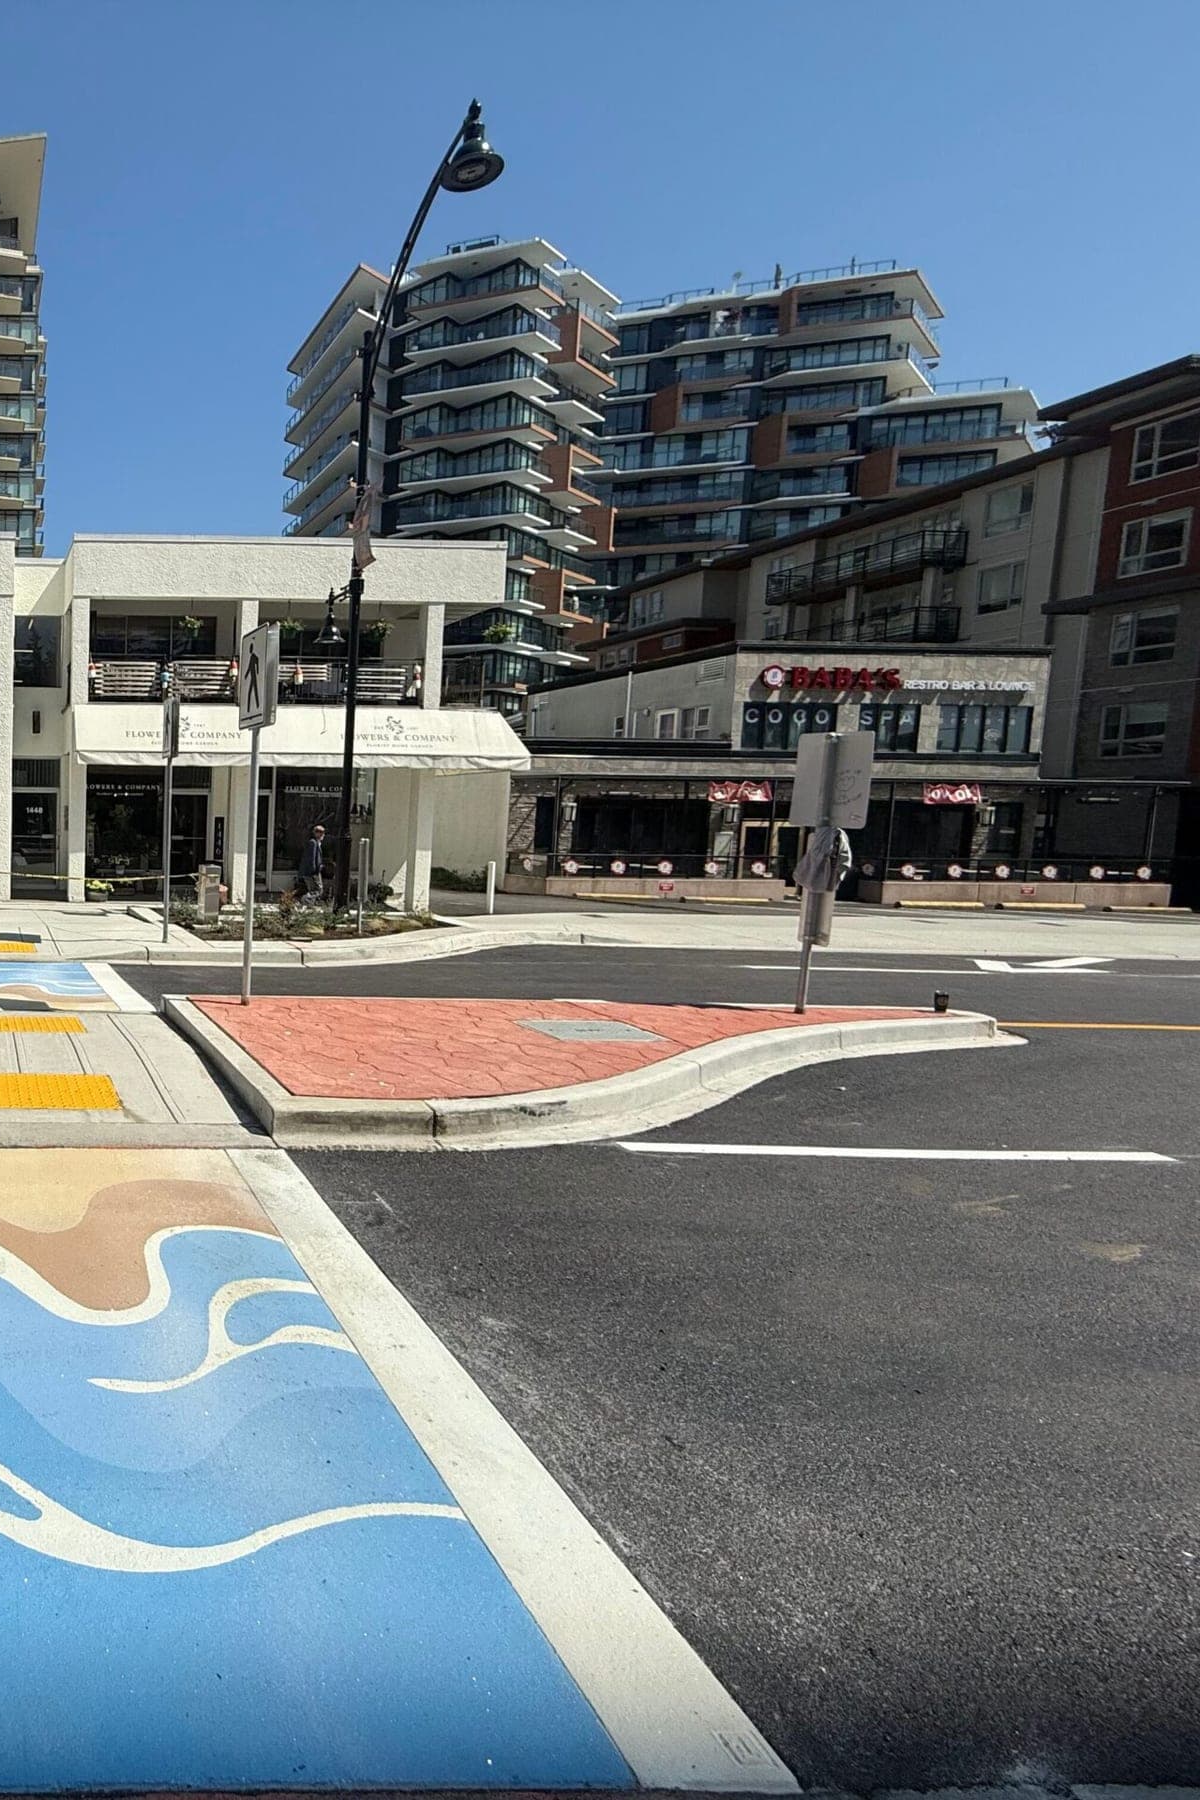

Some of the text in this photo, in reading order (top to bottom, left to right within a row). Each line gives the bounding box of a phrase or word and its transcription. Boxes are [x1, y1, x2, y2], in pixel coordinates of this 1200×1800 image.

[791, 667, 899, 691] BABA'S
[904, 680, 949, 690] RESTRO
[952, 681, 976, 691] BAR
[989, 681, 1036, 691] LOUNGE
[745, 708, 915, 726] COCO SPA
[125, 730, 161, 739] FLOWE
[404, 734, 456, 743] COMPANY
